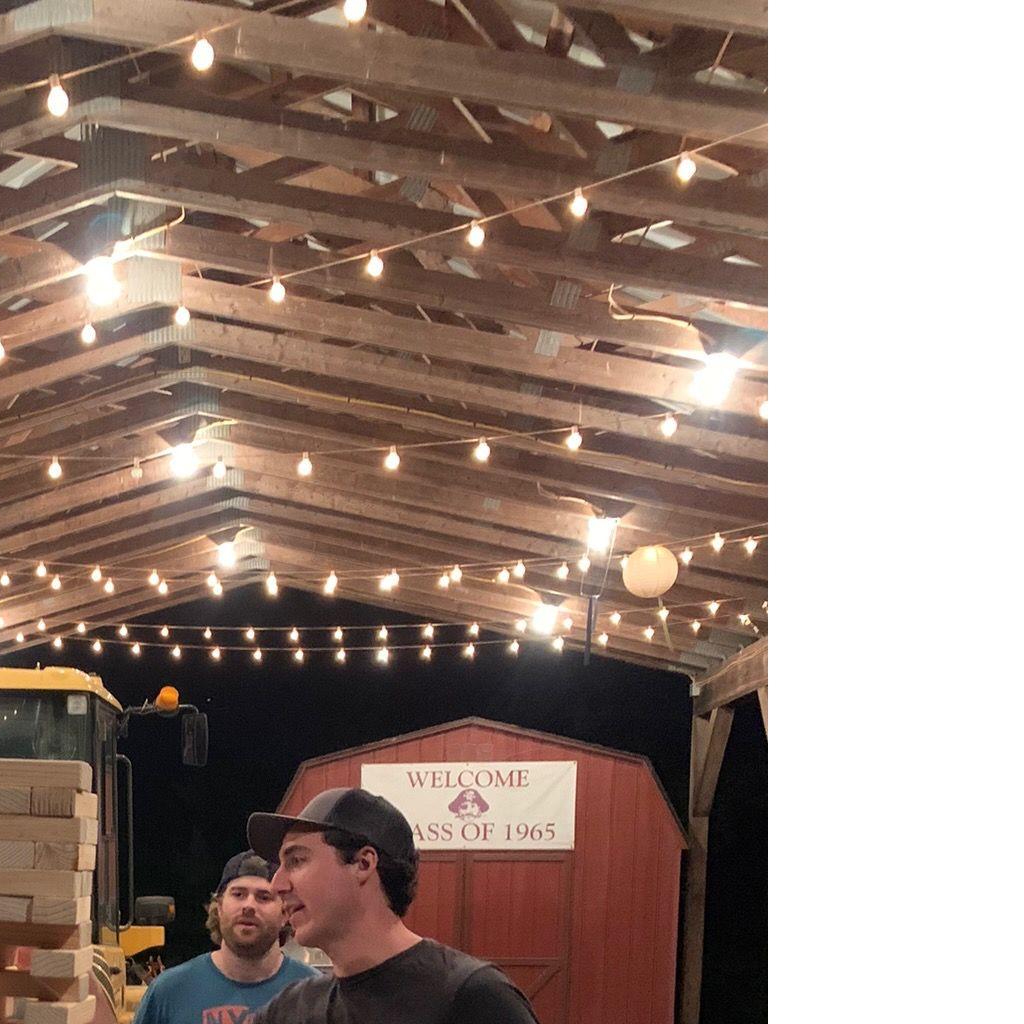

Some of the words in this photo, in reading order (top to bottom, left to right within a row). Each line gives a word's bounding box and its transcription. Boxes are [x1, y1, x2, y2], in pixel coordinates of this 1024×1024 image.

[406, 769, 530, 789] WELCOME
[461, 822, 495, 841] OF
[504, 822, 556, 841] 1965
